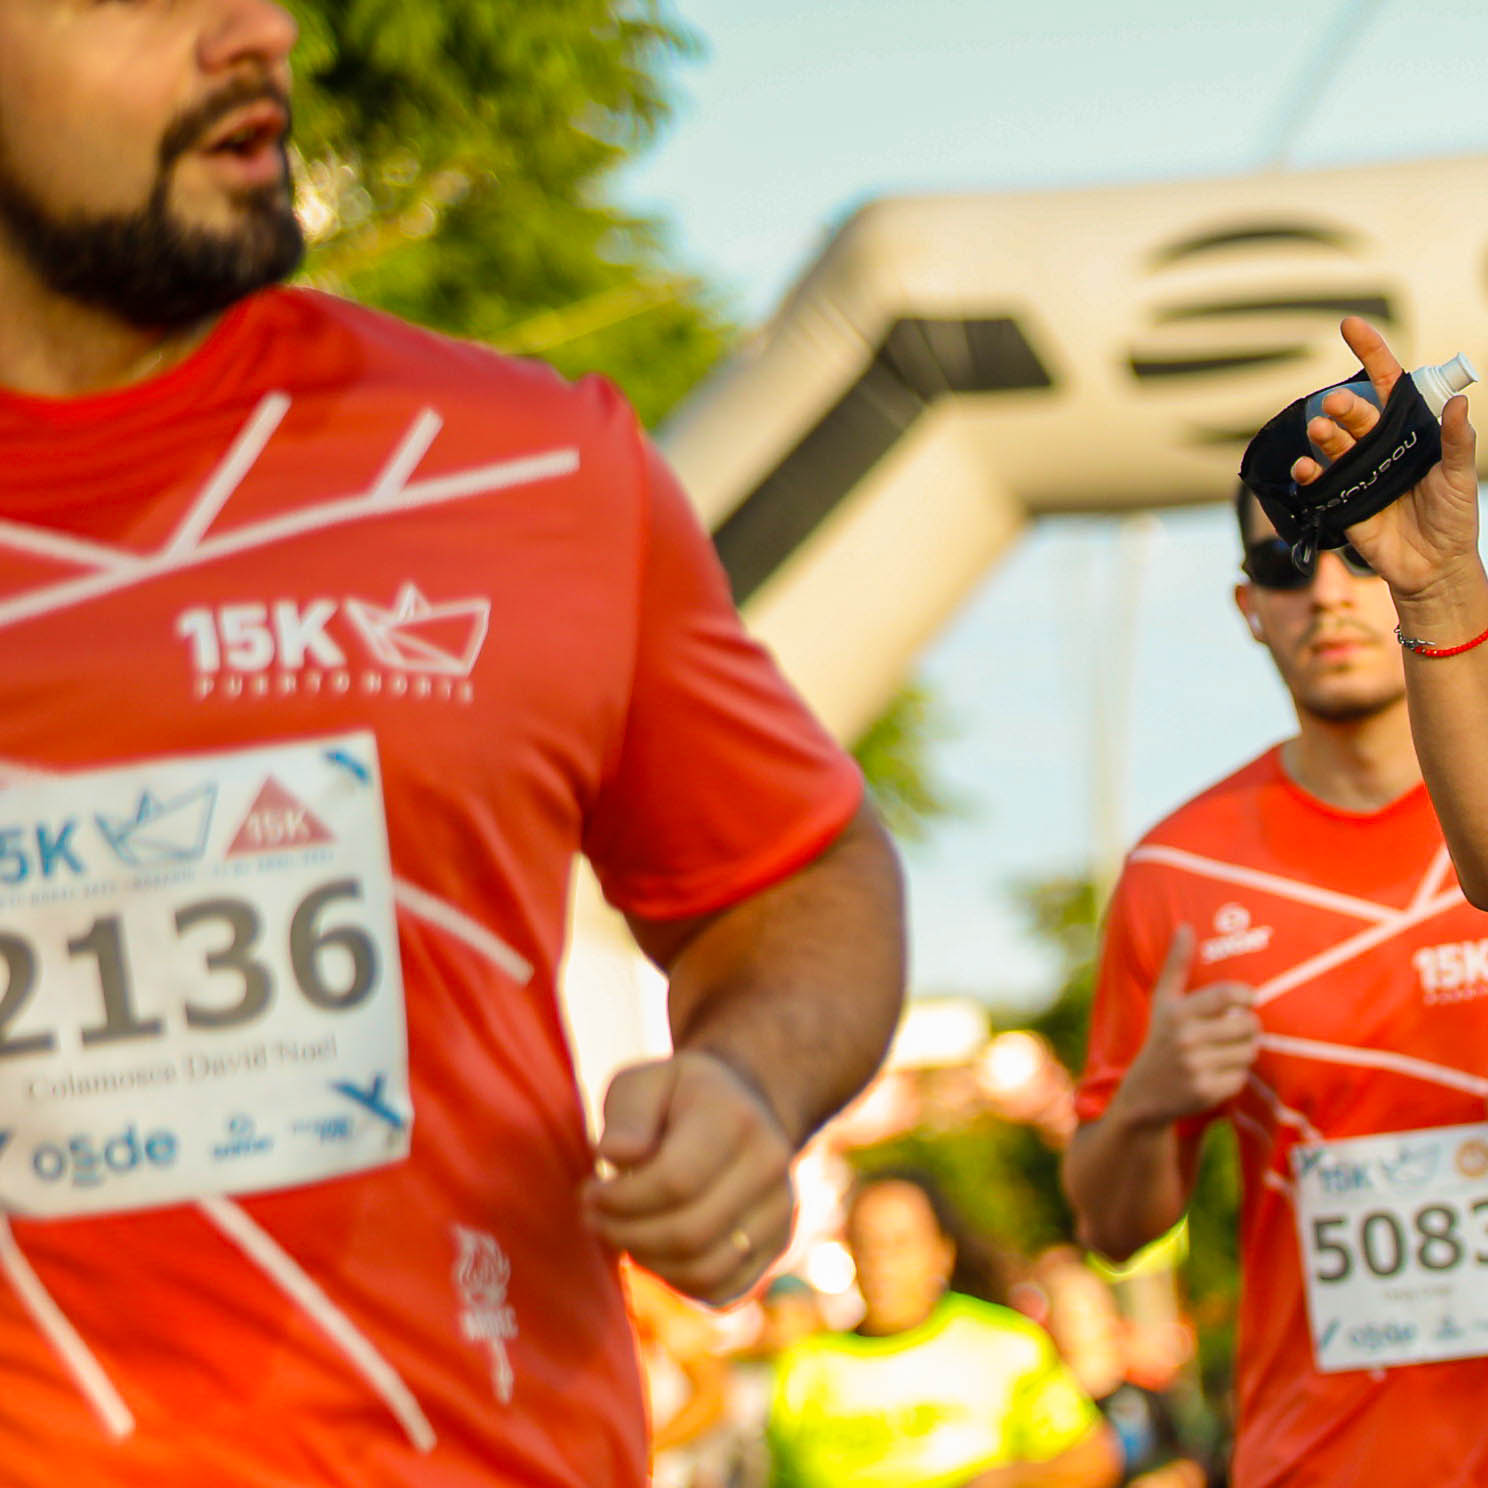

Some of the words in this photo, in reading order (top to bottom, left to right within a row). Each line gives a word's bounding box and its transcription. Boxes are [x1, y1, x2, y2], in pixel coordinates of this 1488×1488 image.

[177, 600, 347, 673] 15K
[0, 819, 86, 885] 5K
[0, 877, 381, 1058] 2136
